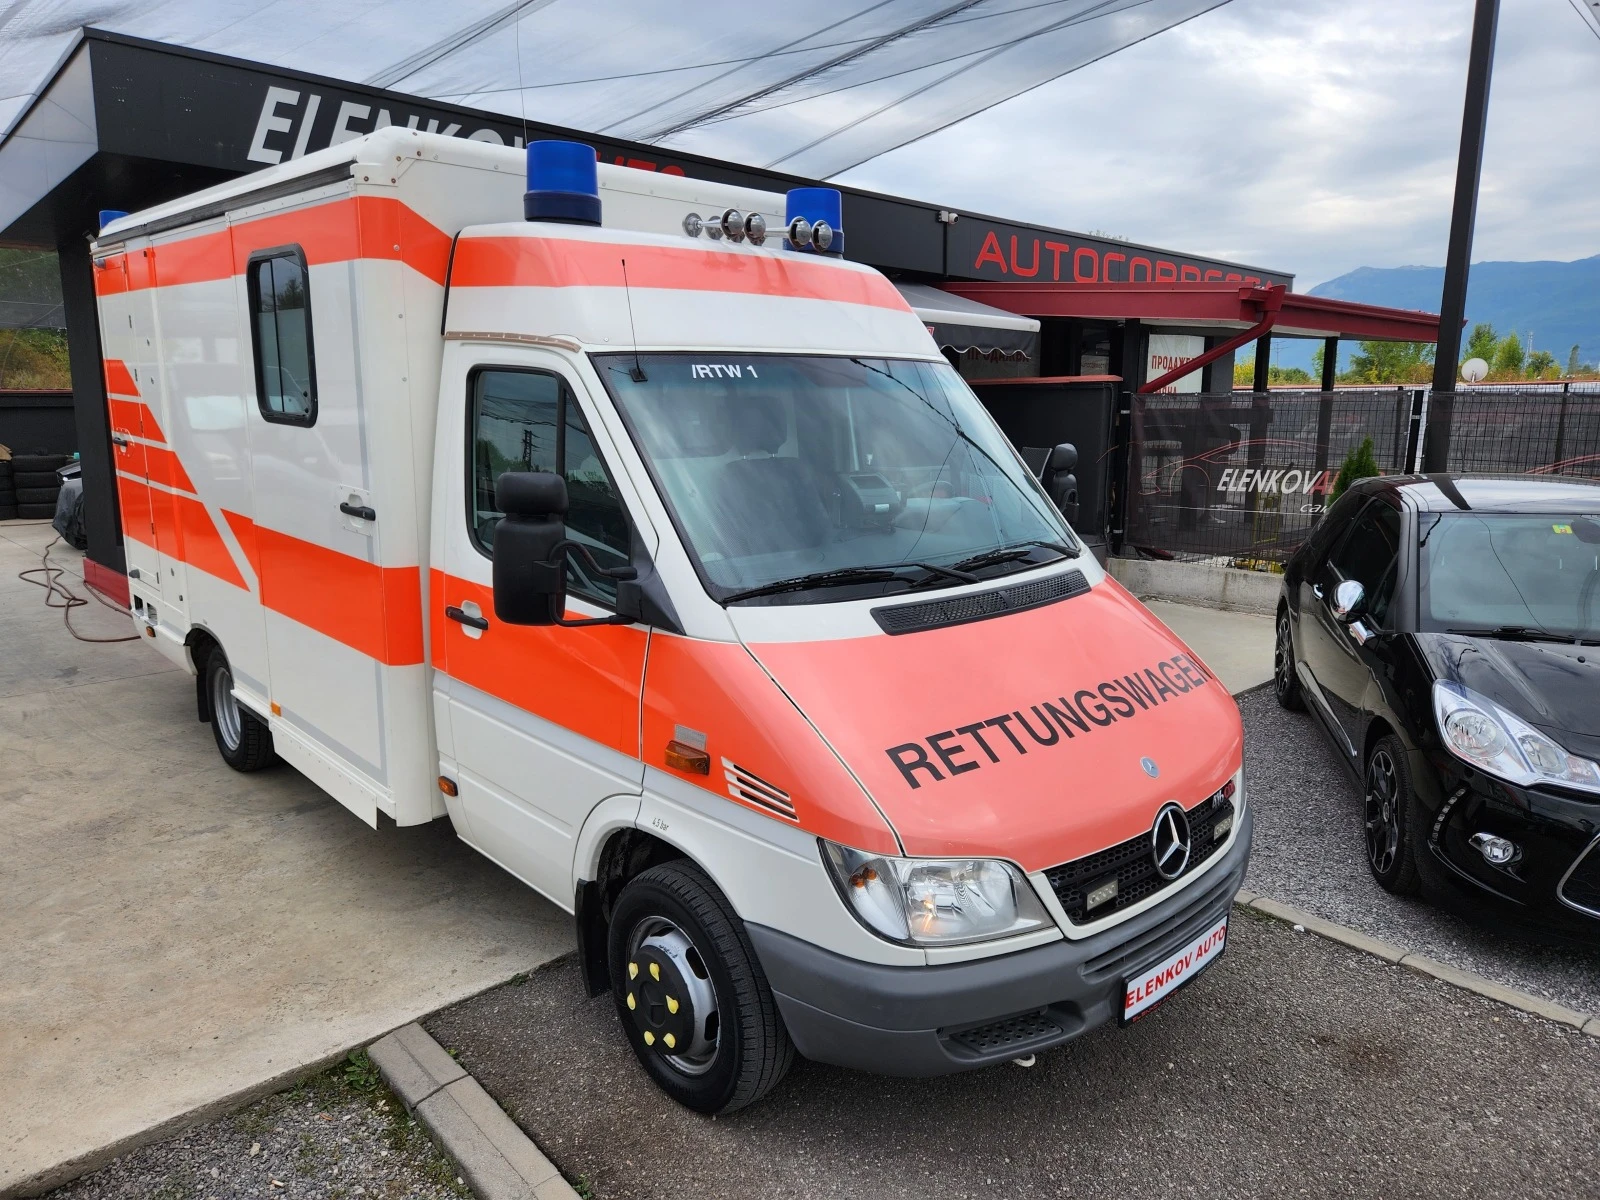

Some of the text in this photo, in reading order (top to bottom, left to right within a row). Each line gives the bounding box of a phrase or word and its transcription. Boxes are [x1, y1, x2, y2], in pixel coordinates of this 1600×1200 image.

[746, 365, 758, 378] 1
[885, 652, 1213, 790] RETTUNGSWAGEN
[1124, 925, 1227, 1009] ELENKOV AUTO
